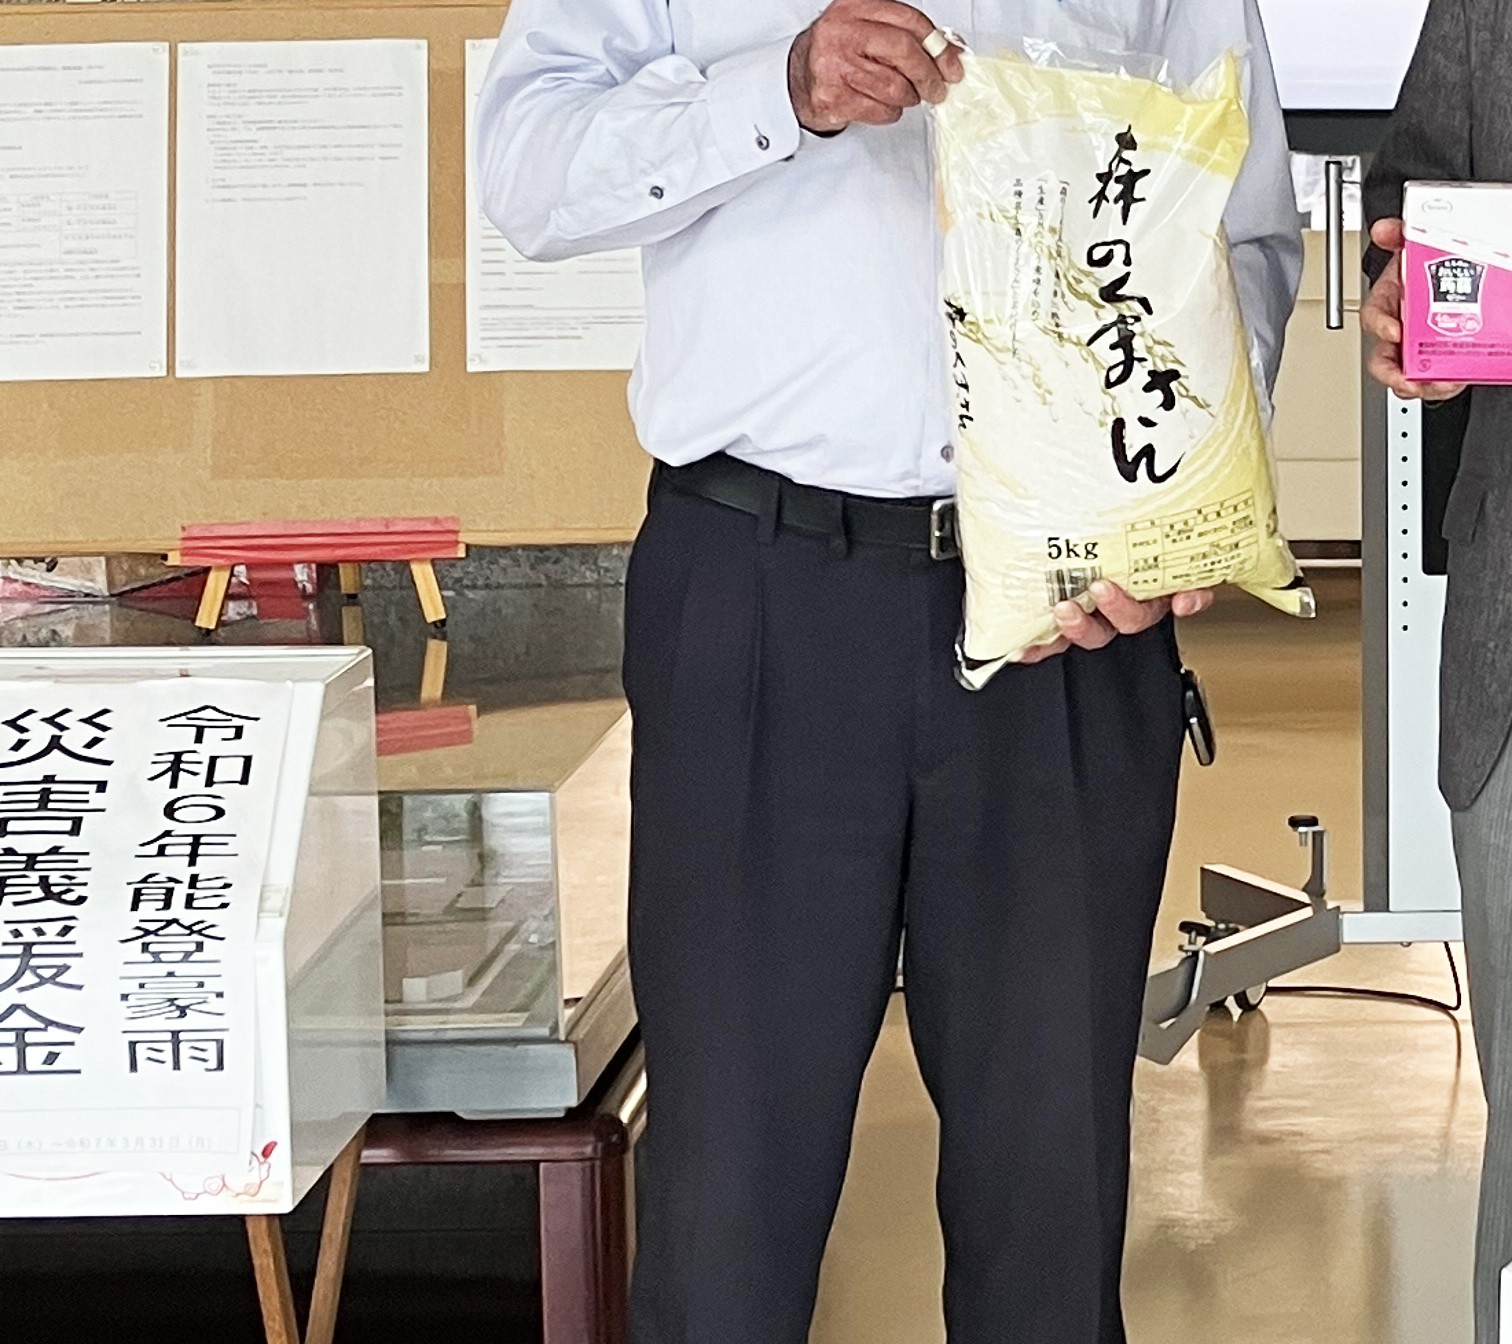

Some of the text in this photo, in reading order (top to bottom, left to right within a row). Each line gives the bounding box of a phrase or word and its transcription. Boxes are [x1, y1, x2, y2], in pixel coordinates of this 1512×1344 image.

[1086, 123, 1186, 484] 森のくまさん
[1046, 536, 1100, 561] 5kg
[117, 704, 261, 1074] 令和6年能登豪雨
